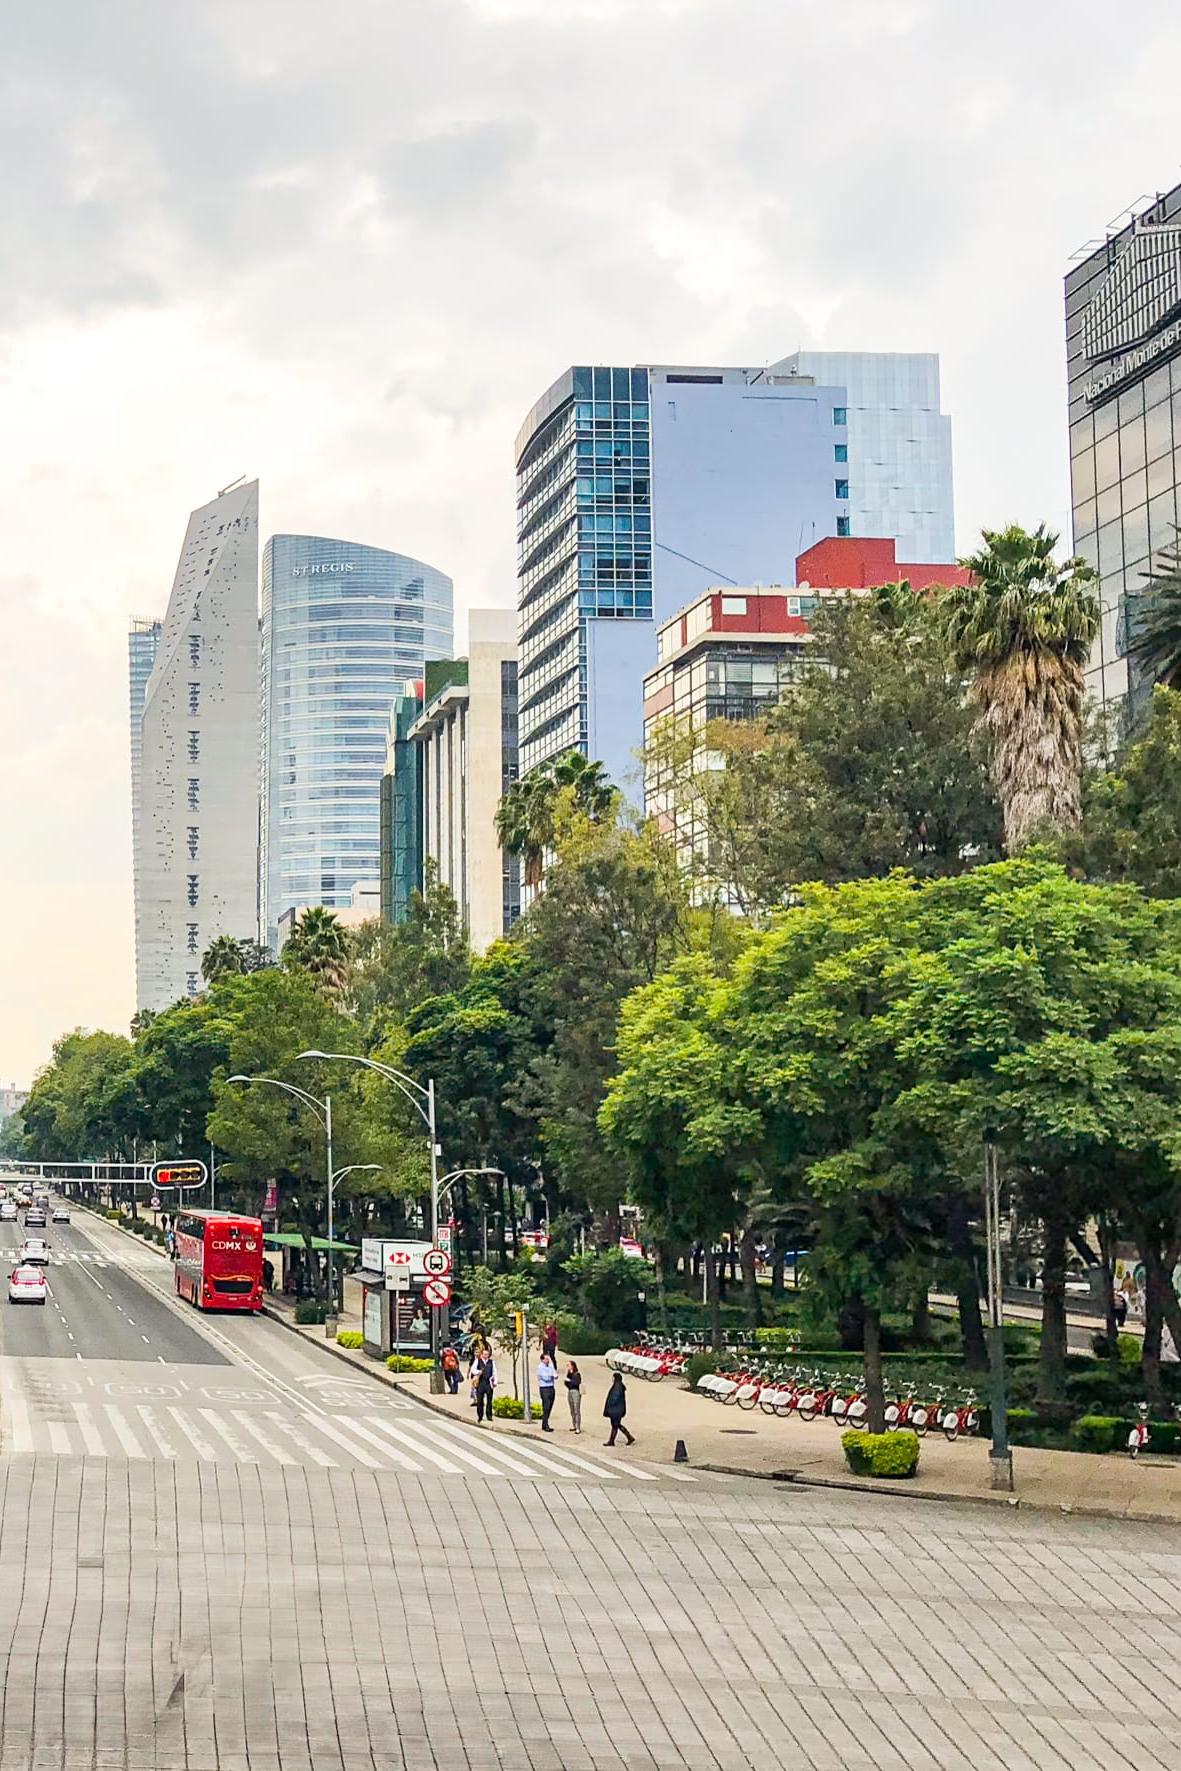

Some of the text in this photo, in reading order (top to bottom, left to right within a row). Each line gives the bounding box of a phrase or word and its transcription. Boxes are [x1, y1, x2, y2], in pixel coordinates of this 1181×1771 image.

[1084, 357, 1126, 403] Nacional
[1126, 342, 1159, 374] Monte
[1161, 329, 1175, 350] de
[311, 562, 354, 574] REGIS
[211, 1241, 241, 1250] CDMX
